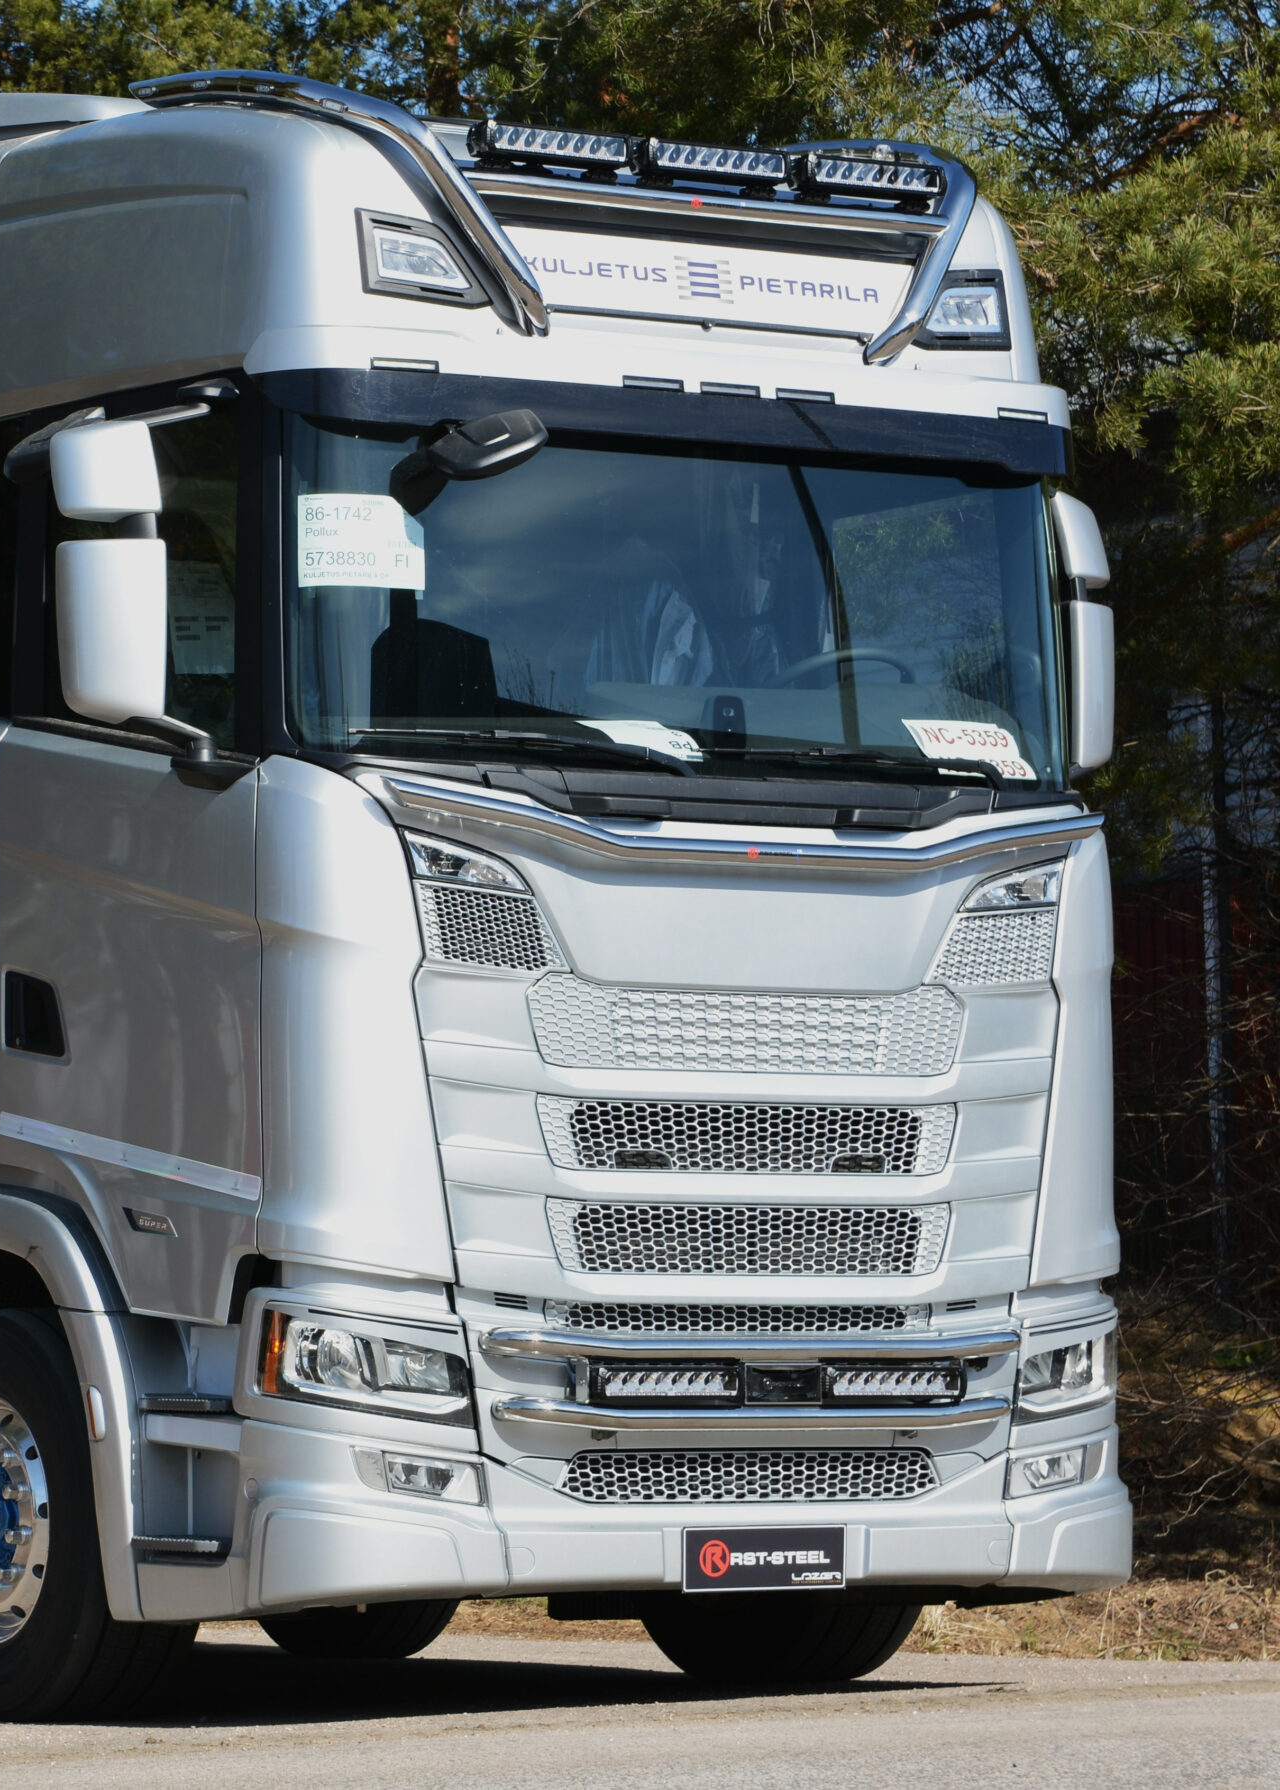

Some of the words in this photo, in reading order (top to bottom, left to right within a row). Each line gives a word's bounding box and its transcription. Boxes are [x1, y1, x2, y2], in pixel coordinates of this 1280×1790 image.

[523, 255, 668, 284] KULJETUS
[739, 274, 880, 304] PIETARILA
[305, 506, 372, 522] 86-1742
[305, 527, 339, 537] Pollux
[305, 551, 376, 567] 5738830
[395, 554, 409, 568] FI
[922, 727, 1008, 748] NC-5359
[139, 1219, 167, 1231] SUPER
[730, 1550, 830, 1566] RST-STEEL
